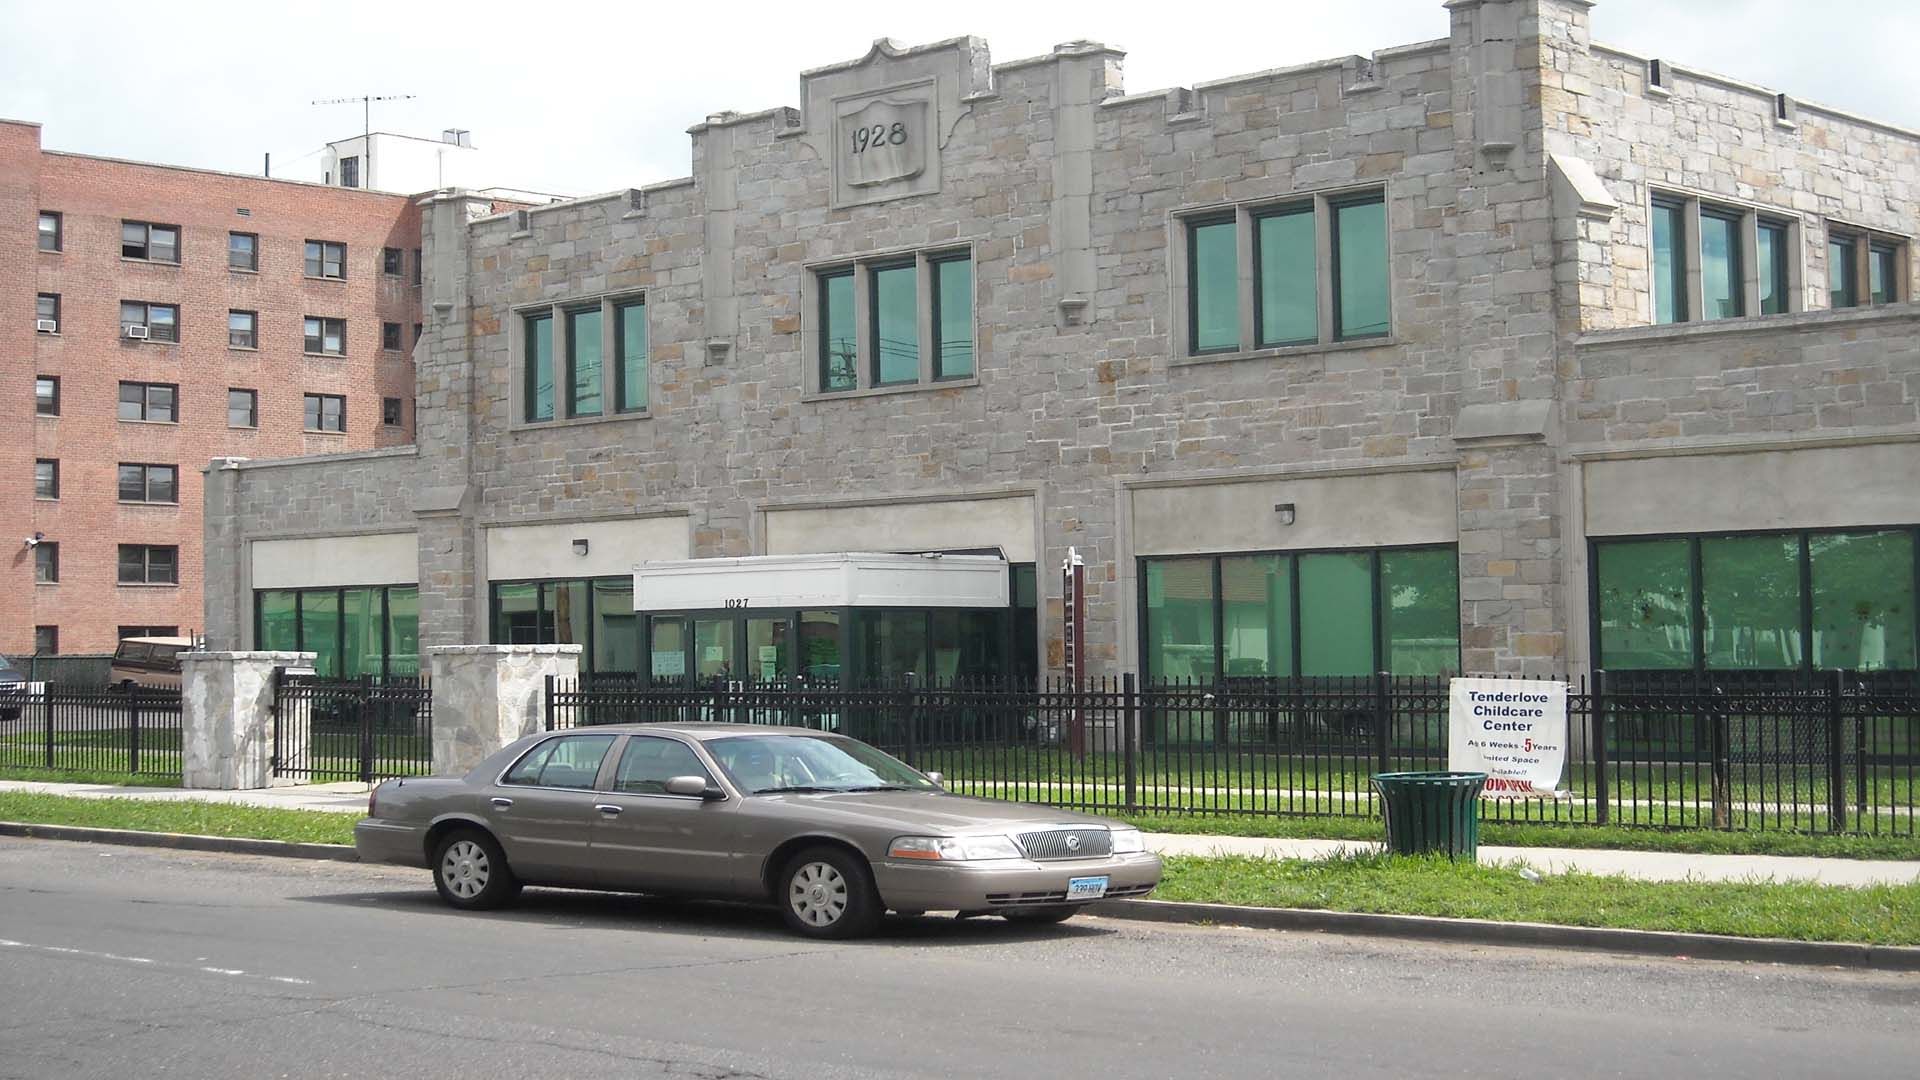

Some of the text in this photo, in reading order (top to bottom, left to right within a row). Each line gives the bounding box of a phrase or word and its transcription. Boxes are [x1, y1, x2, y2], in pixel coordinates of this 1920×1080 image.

[851, 122, 907, 153] 1928
[724, 598, 749, 609] 1027
[1469, 691, 1548, 703] Tenderlove
[1473, 705, 1543, 717] Childcare
[1483, 720, 1533, 732] Center
[1489, 741, 1518, 749] Weeks
[1524, 738, 1531, 752] 5
[1511, 756, 1540, 764] Space
